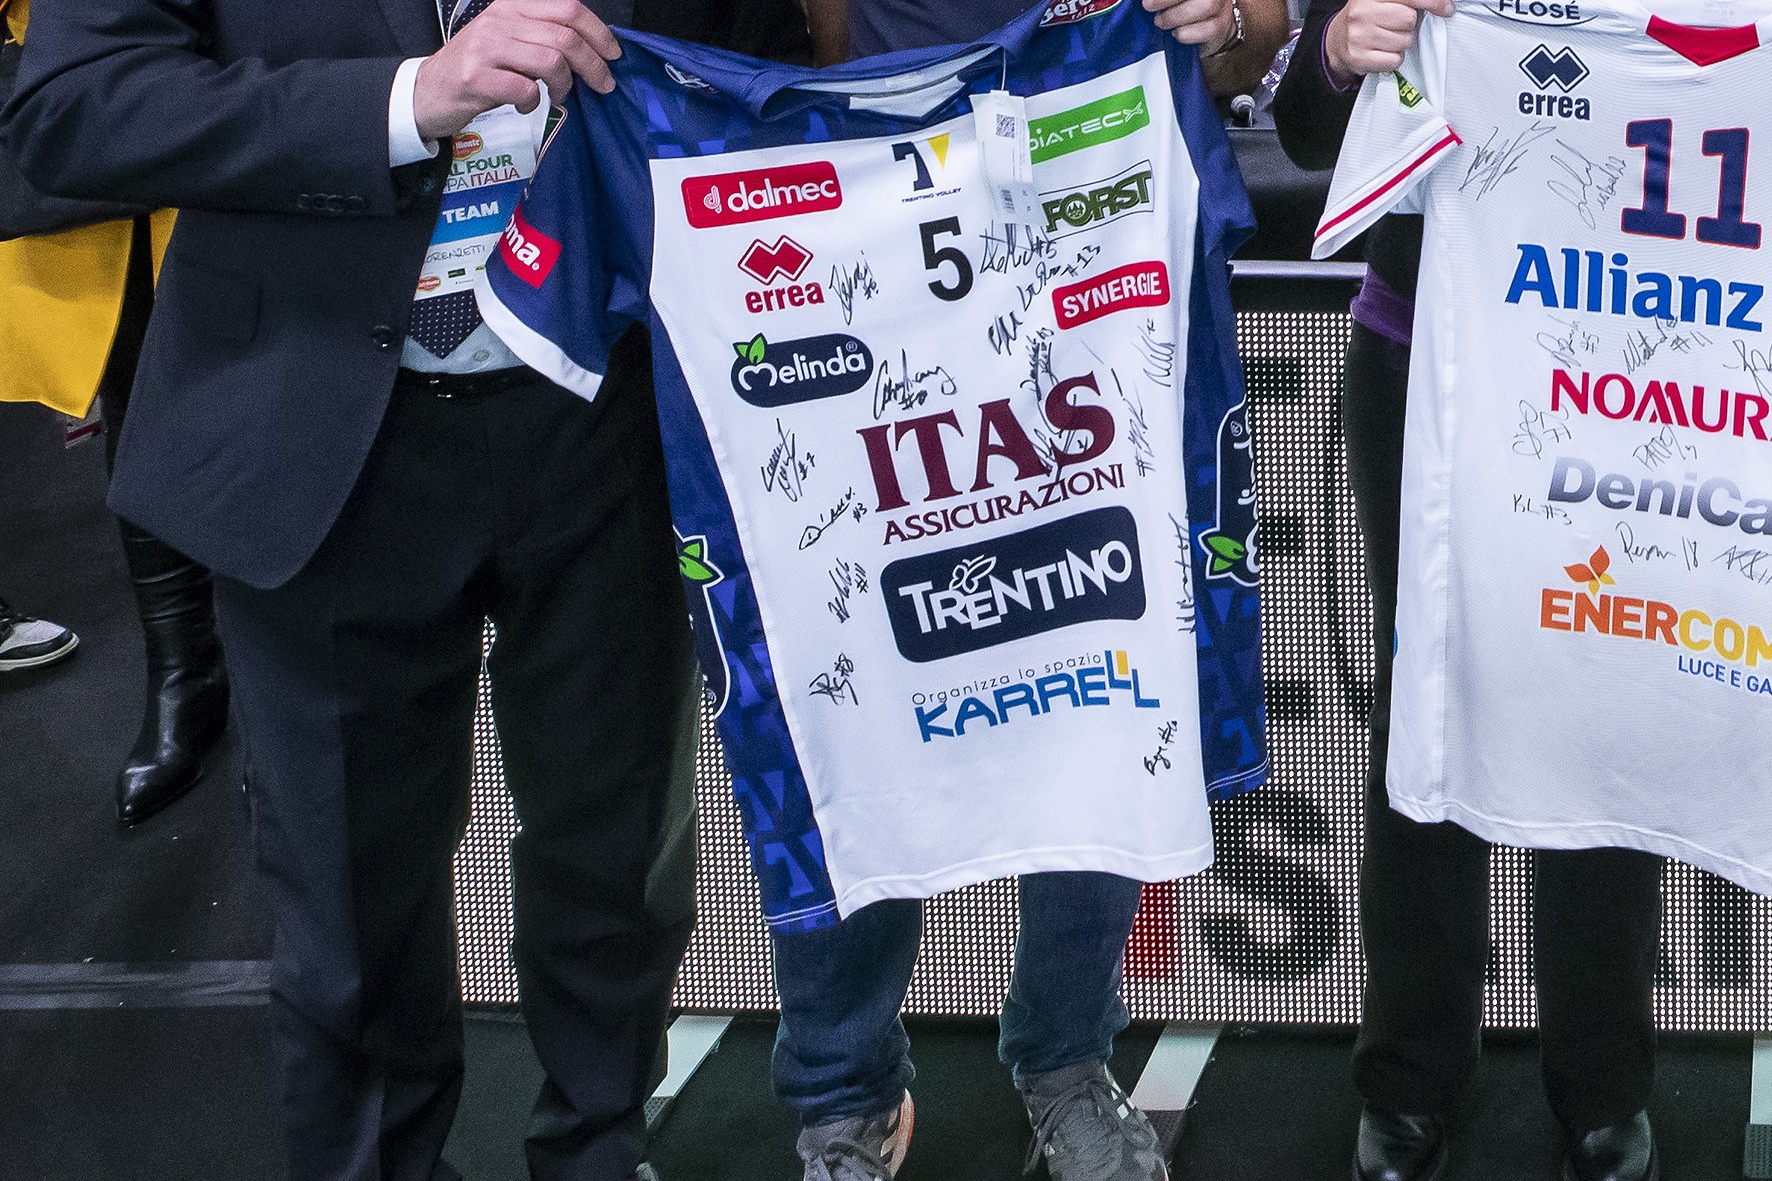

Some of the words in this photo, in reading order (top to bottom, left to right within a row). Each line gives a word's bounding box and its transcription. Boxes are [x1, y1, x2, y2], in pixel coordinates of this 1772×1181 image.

[1518, 91, 1591, 120] errea
[467, 153, 514, 175] FOUR
[470, 167, 520, 187] ITALIA
[1621, 118, 1762, 250] 11
[442, 201, 499, 224] TEAM
[728, 168, 838, 213] dalmec
[1042, 169, 1152, 233] FORST
[919, 216, 974, 302] 5
[745, 281, 825, 314] errea
[1062, 271, 1162, 319] SYNERGIE
[1504, 243, 1764, 333] Allianz
[738, 345, 866, 391] Melinda
[856, 369, 1117, 513] ITAS
[882, 463, 1125, 546] ASSICURAZIONI
[899, 542, 1133, 634] TRENTINO
[912, 673, 1011, 705] Organizza
[1019, 665, 1036, 680] lo
[1042, 652, 1102, 678] spazio
[914, 649, 1161, 743] KARRELL
[1678, 655, 1726, 684] LUCE
[1730, 670, 1741, 688] E
